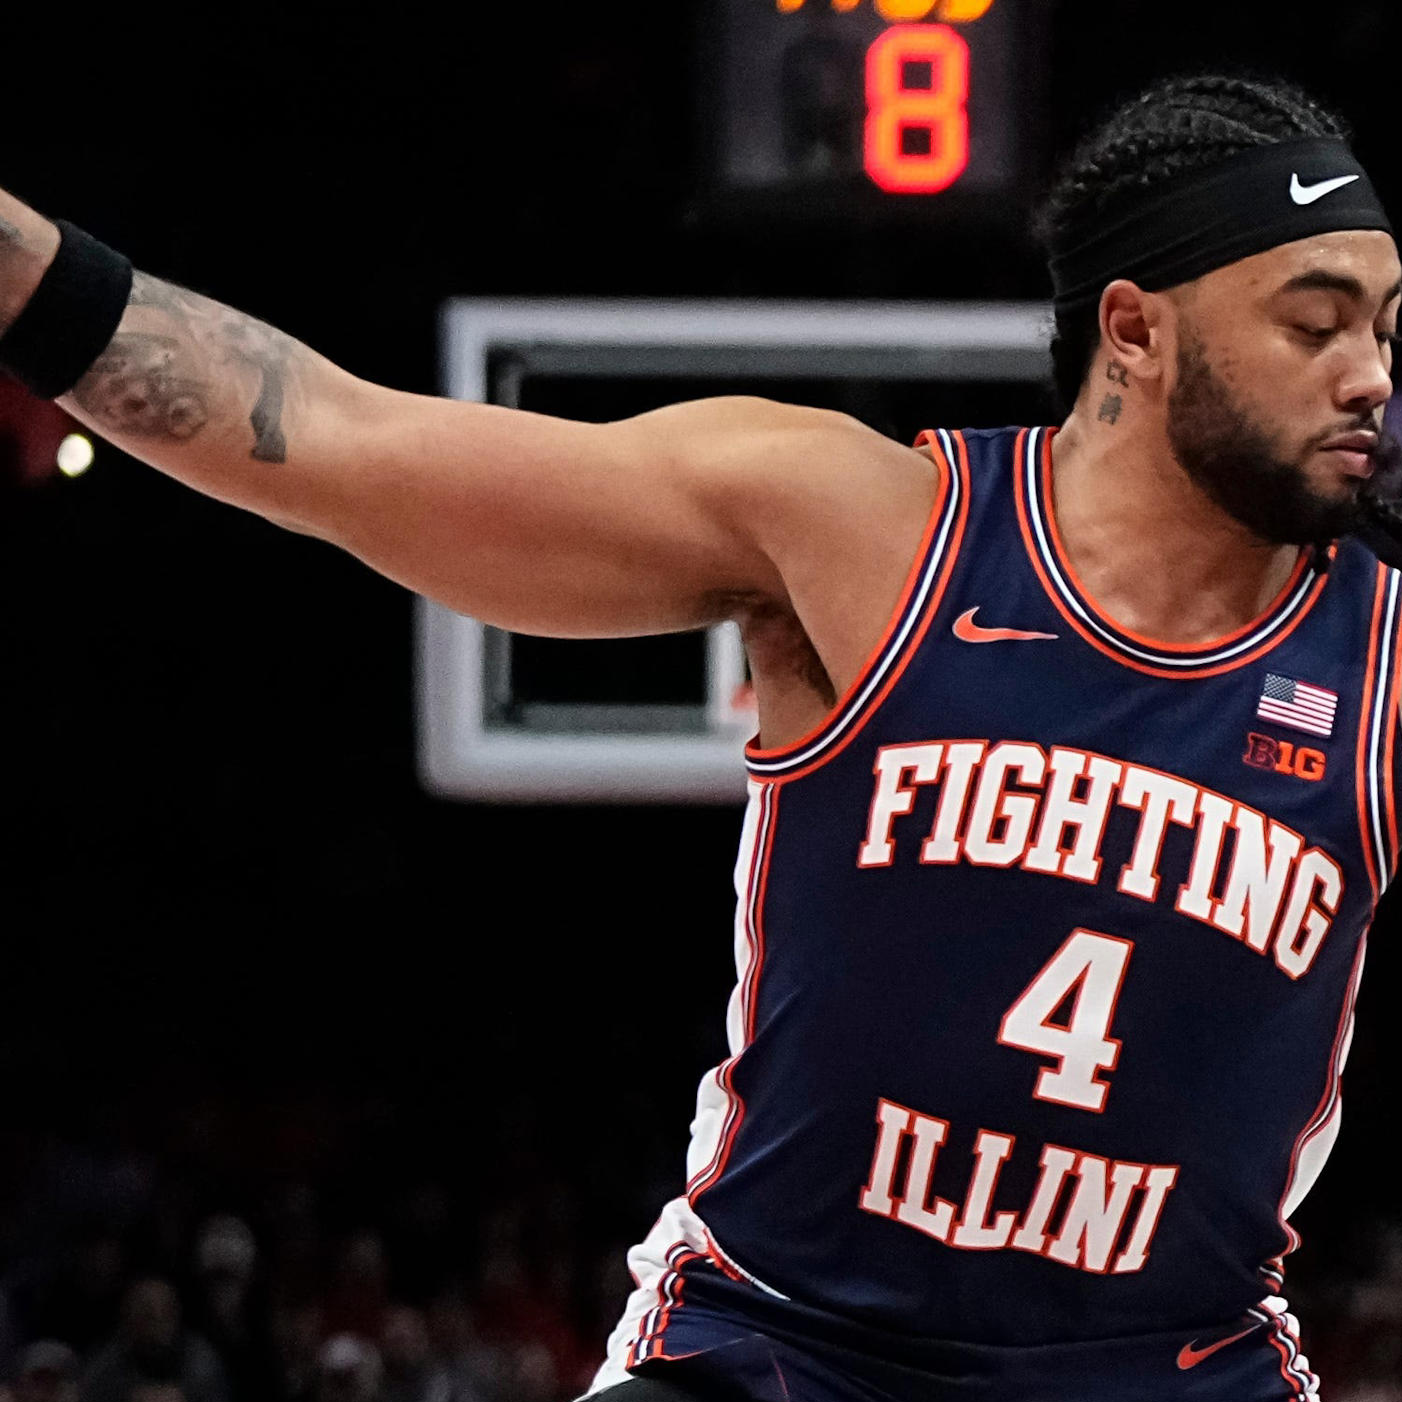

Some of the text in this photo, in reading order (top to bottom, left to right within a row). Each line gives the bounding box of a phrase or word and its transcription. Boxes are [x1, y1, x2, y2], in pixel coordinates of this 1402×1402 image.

[863, 23, 971, 195] 8
[857, 739, 1345, 981] FIGHTING
[996, 926, 1135, 1113] 4
[858, 1097, 1181, 1275] ILLINI
